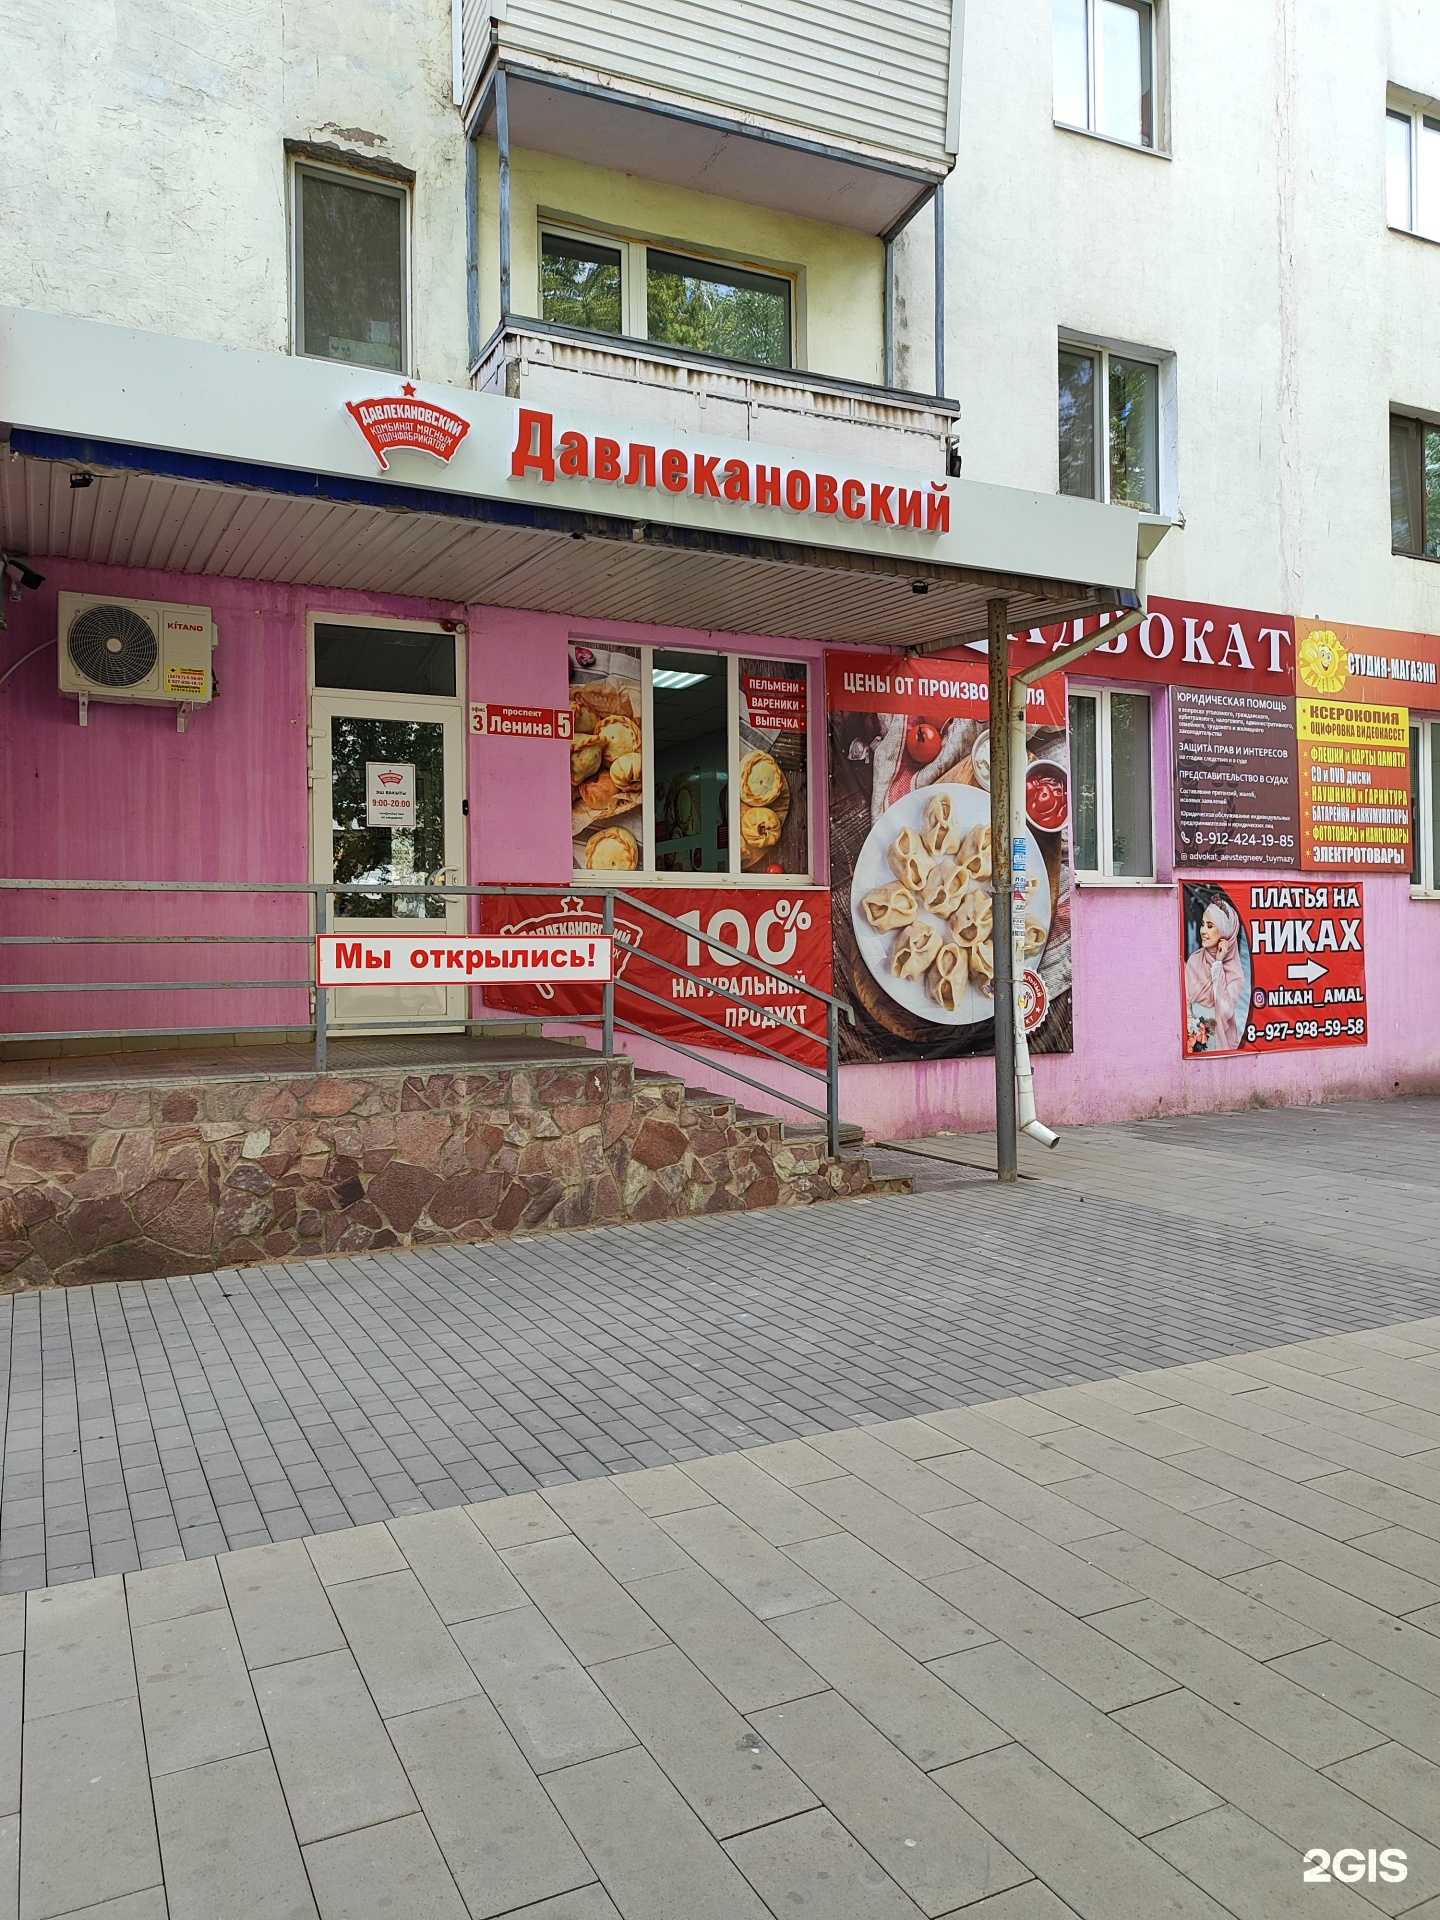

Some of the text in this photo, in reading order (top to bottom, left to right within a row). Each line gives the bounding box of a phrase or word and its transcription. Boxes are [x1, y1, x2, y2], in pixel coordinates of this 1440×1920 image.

[359, 404, 463, 437] ДАВЛЕКАНОВСКИЙ
[371, 422, 453, 445] КОМБИНАТ МЯСНЫХ
[378, 432, 446, 452] ПОЛУФАБРИКАТОВ
[511, 408, 950, 532] Давлекановский
[1348, 653, 1437, 684] СТУДИЯ-МАГАЗИН
[749, 679, 799, 693] ПЕЛЬМЕНИ
[844, 672, 1045, 706] ЦЕНЫ ОТ ПРОИЗВОЛЯ
[752, 697, 799, 711] ВАРЕНИКИ
[1177, 692, 1287, 712] ЮРИДИЧЕСКАЯ ПОМОЩЬ
[502, 708, 542, 718] проспект
[755, 716, 799, 729] ВЫПЕЧКА
[1309, 705, 1400, 725] КСЕРОКОПИЯ
[473, 715, 484, 732] 3
[489, 713, 571, 738] Ленина 5
[1310, 721, 1405, 742] ОЦИФРОВКА ВИДЕОКАССЕТ
[1178, 742, 1288, 758] ЗАЩИТА ПРАВ И ИНТЕРЕСОВ
[1310, 745, 1406, 768] ФЛЕШКИ и КАРТЫ ПАМЯТИ
[1179, 770, 1258, 783] ПРЕДСТАВИТЕЛЬСТВО
[1265, 776, 1289, 786] СУДАХ
[1322, 770, 1329, 782] и
[1329, 767, 1344, 784] DVD
[1346, 771, 1372, 786] диски
[1311, 786, 1408, 806] НАУШНИКИ и ГАРНИТУРА
[1312, 804, 1409, 825] БАТАРЕЙКИ и АККУМУЛЯТОРЫ
[1195, 832, 1294, 847] 8-912-424-19-85
[1312, 825, 1409, 845] ФОТОТОВАРЫ и КАНЦТОВАРЫ
[1313, 846, 1405, 864] ЭЛЕКТРОТОВАРЫ
[1250, 887, 1360, 908] ПЛАТЬЯ НА
[1250, 919, 1362, 954] НИКАХ
[335, 943, 391, 969] Мы
[410, 943, 596, 975] открылись!
[1247, 1019, 1364, 1041] 8-927-928-59-58
